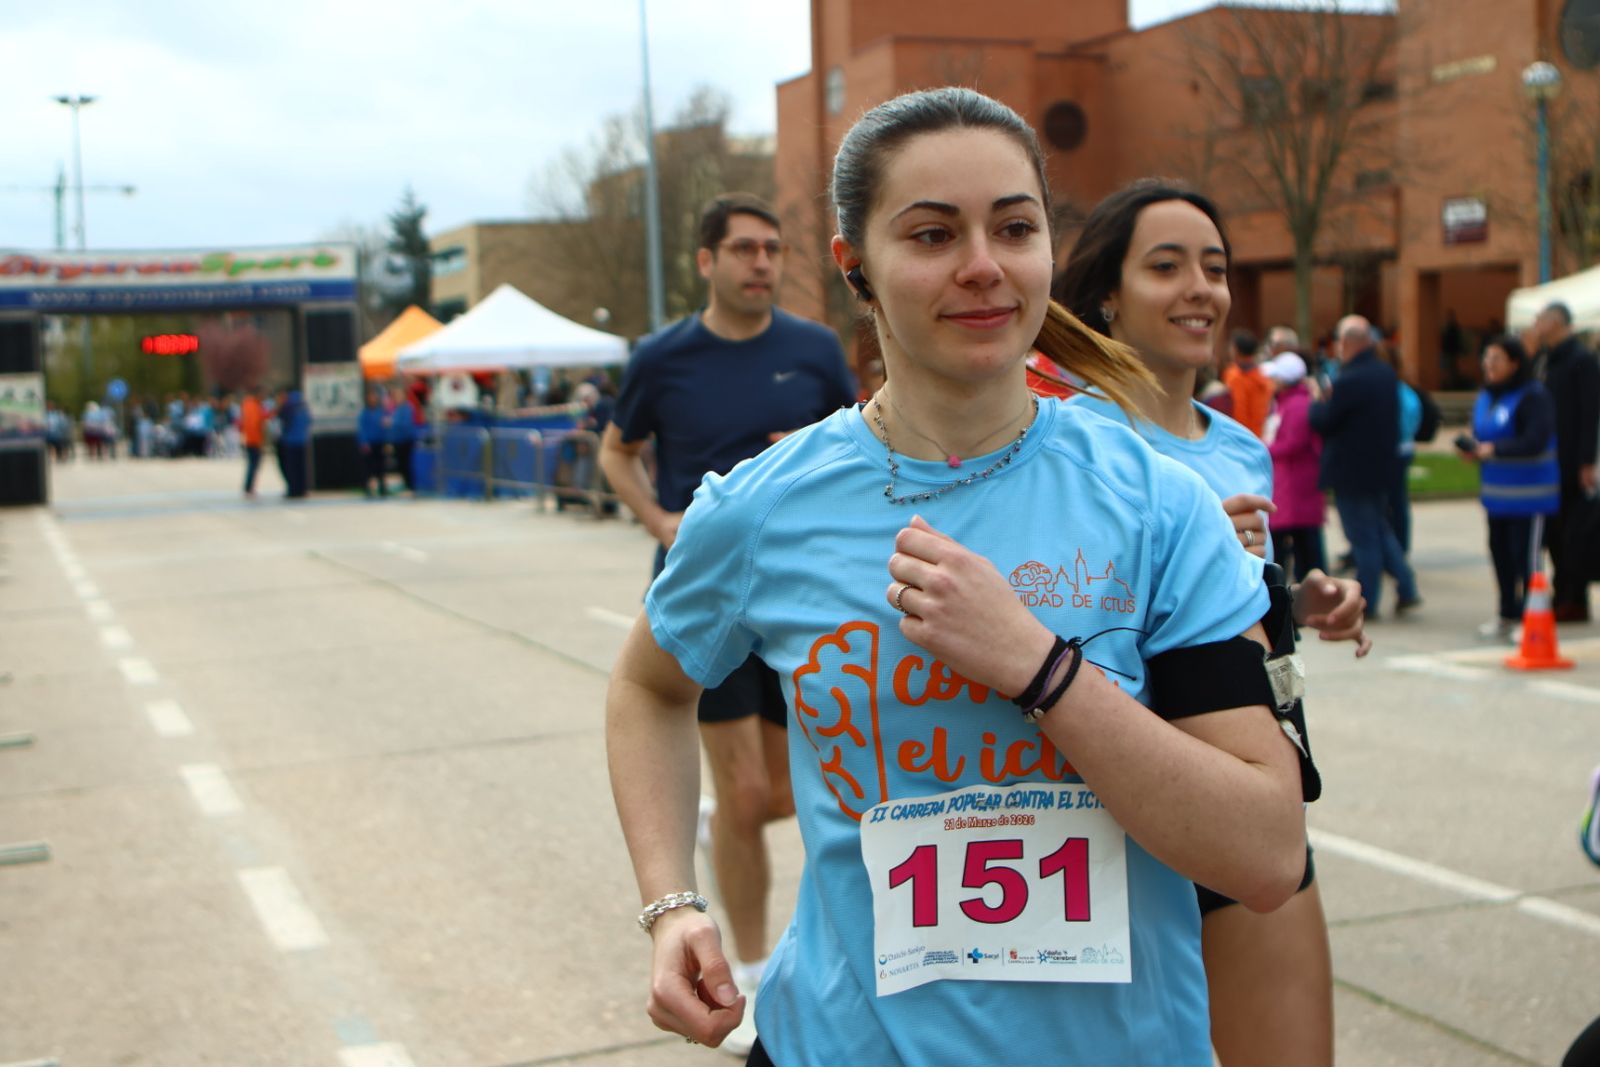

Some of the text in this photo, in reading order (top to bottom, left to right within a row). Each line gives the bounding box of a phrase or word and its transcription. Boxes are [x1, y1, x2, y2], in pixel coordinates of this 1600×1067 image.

[1020, 594, 1136, 613] IDAD DE ICTUS
[897, 726, 1078, 783] el ict
[870, 806, 889, 823] II
[891, 800, 945, 820] CARRERA
[1005, 790, 1055, 809] CONTRA
[1058, 790, 1073, 809] EL
[944, 813, 1035, 830] 21 de Marzo de 2026
[889, 837, 1091, 927] 151
